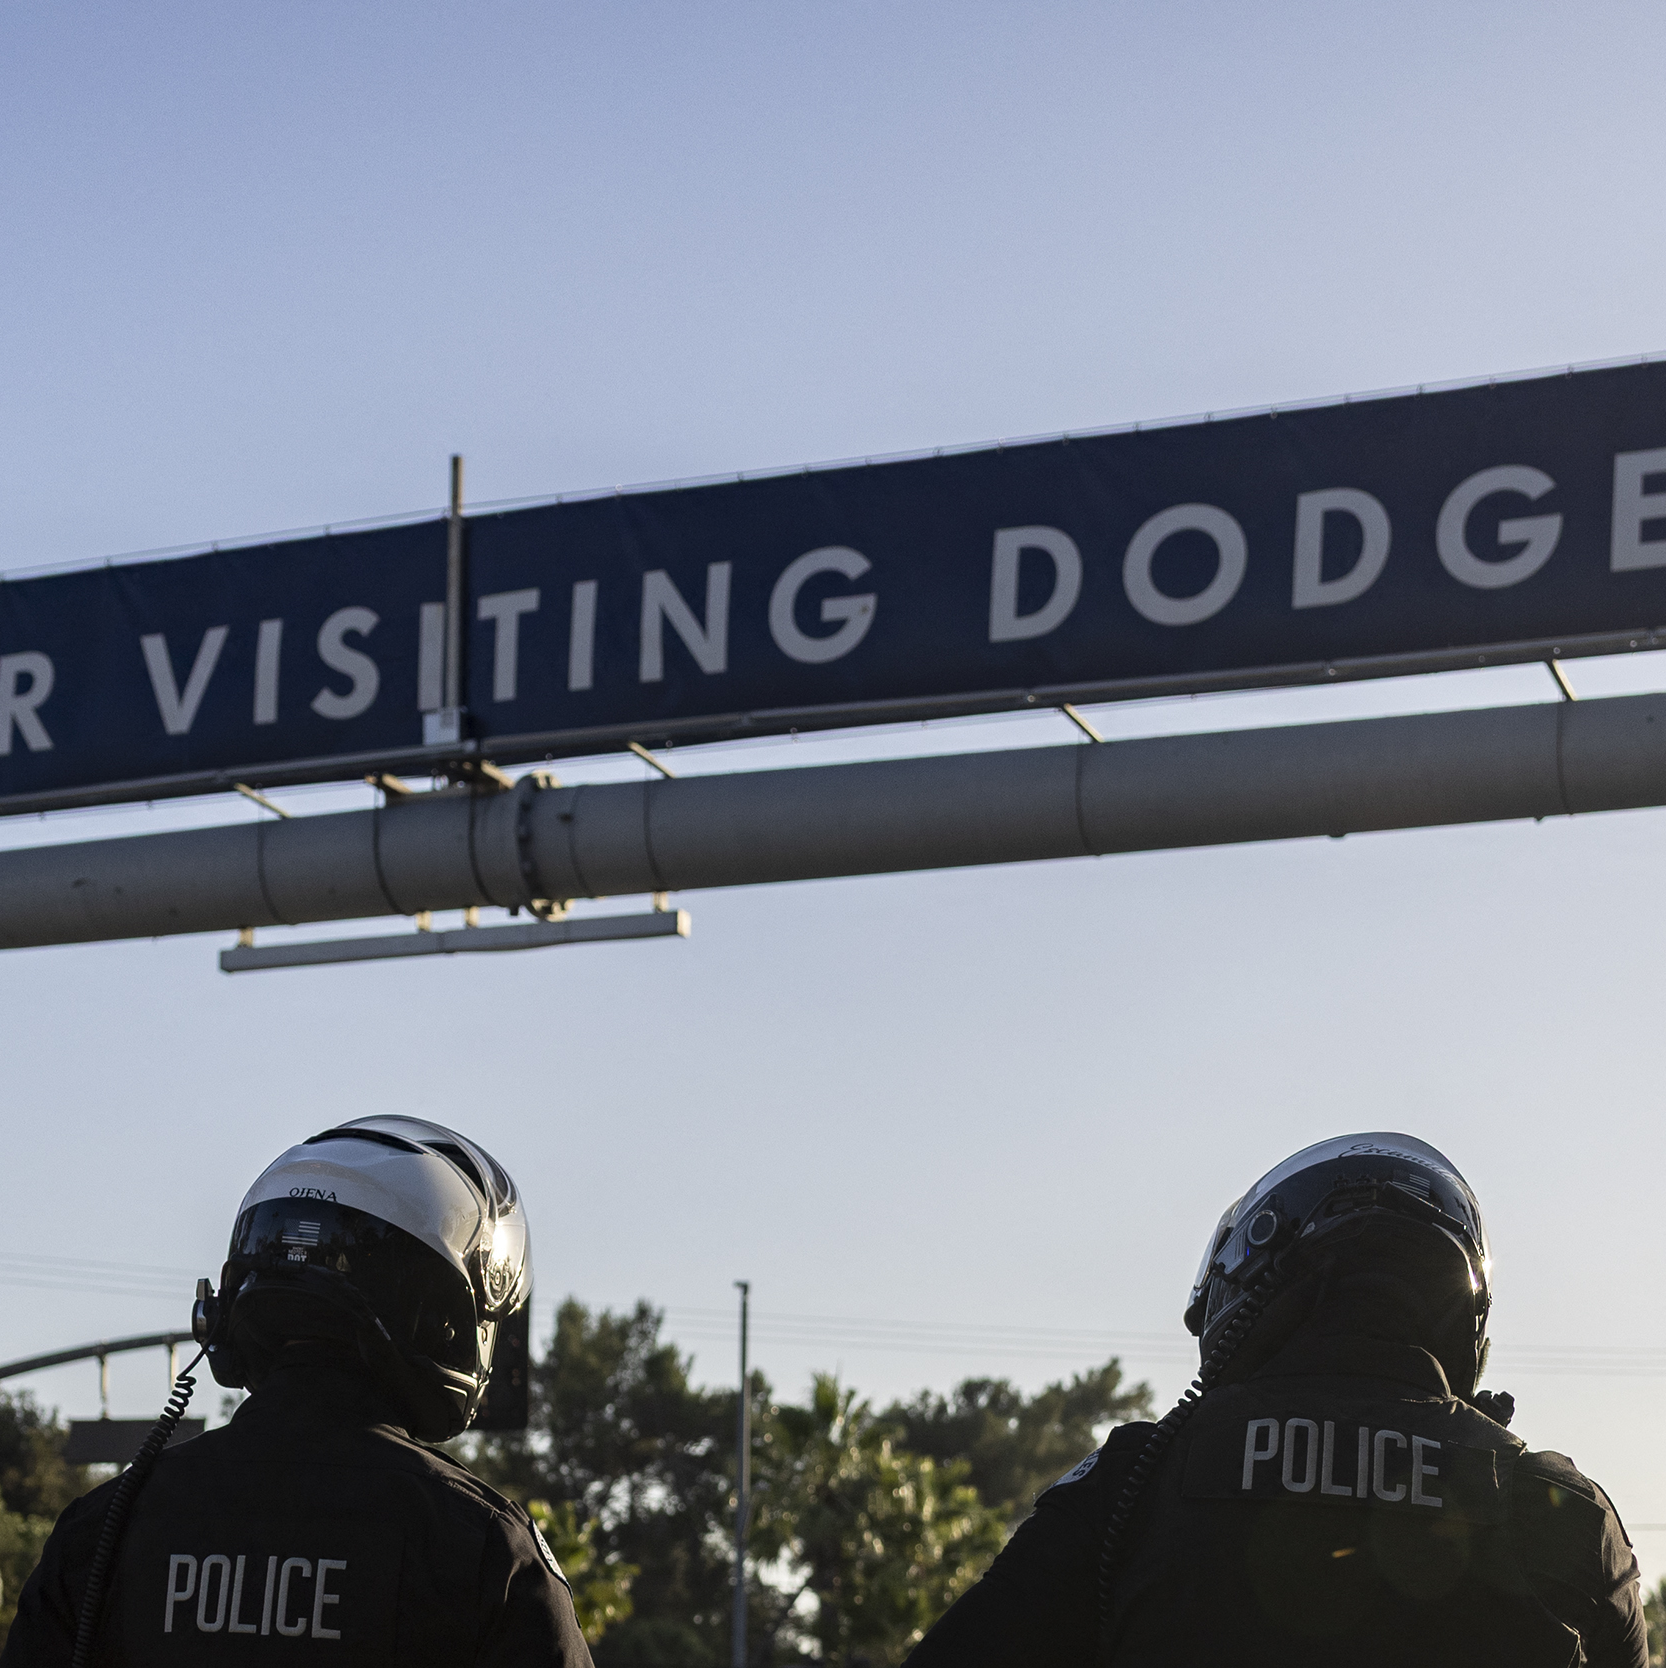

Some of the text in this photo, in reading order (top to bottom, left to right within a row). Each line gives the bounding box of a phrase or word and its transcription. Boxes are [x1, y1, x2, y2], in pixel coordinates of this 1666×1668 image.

[141, 545, 880, 736] VISITING
[1242, 1416, 1444, 1508] POLICE
[163, 1553, 348, 1640] POLICE
